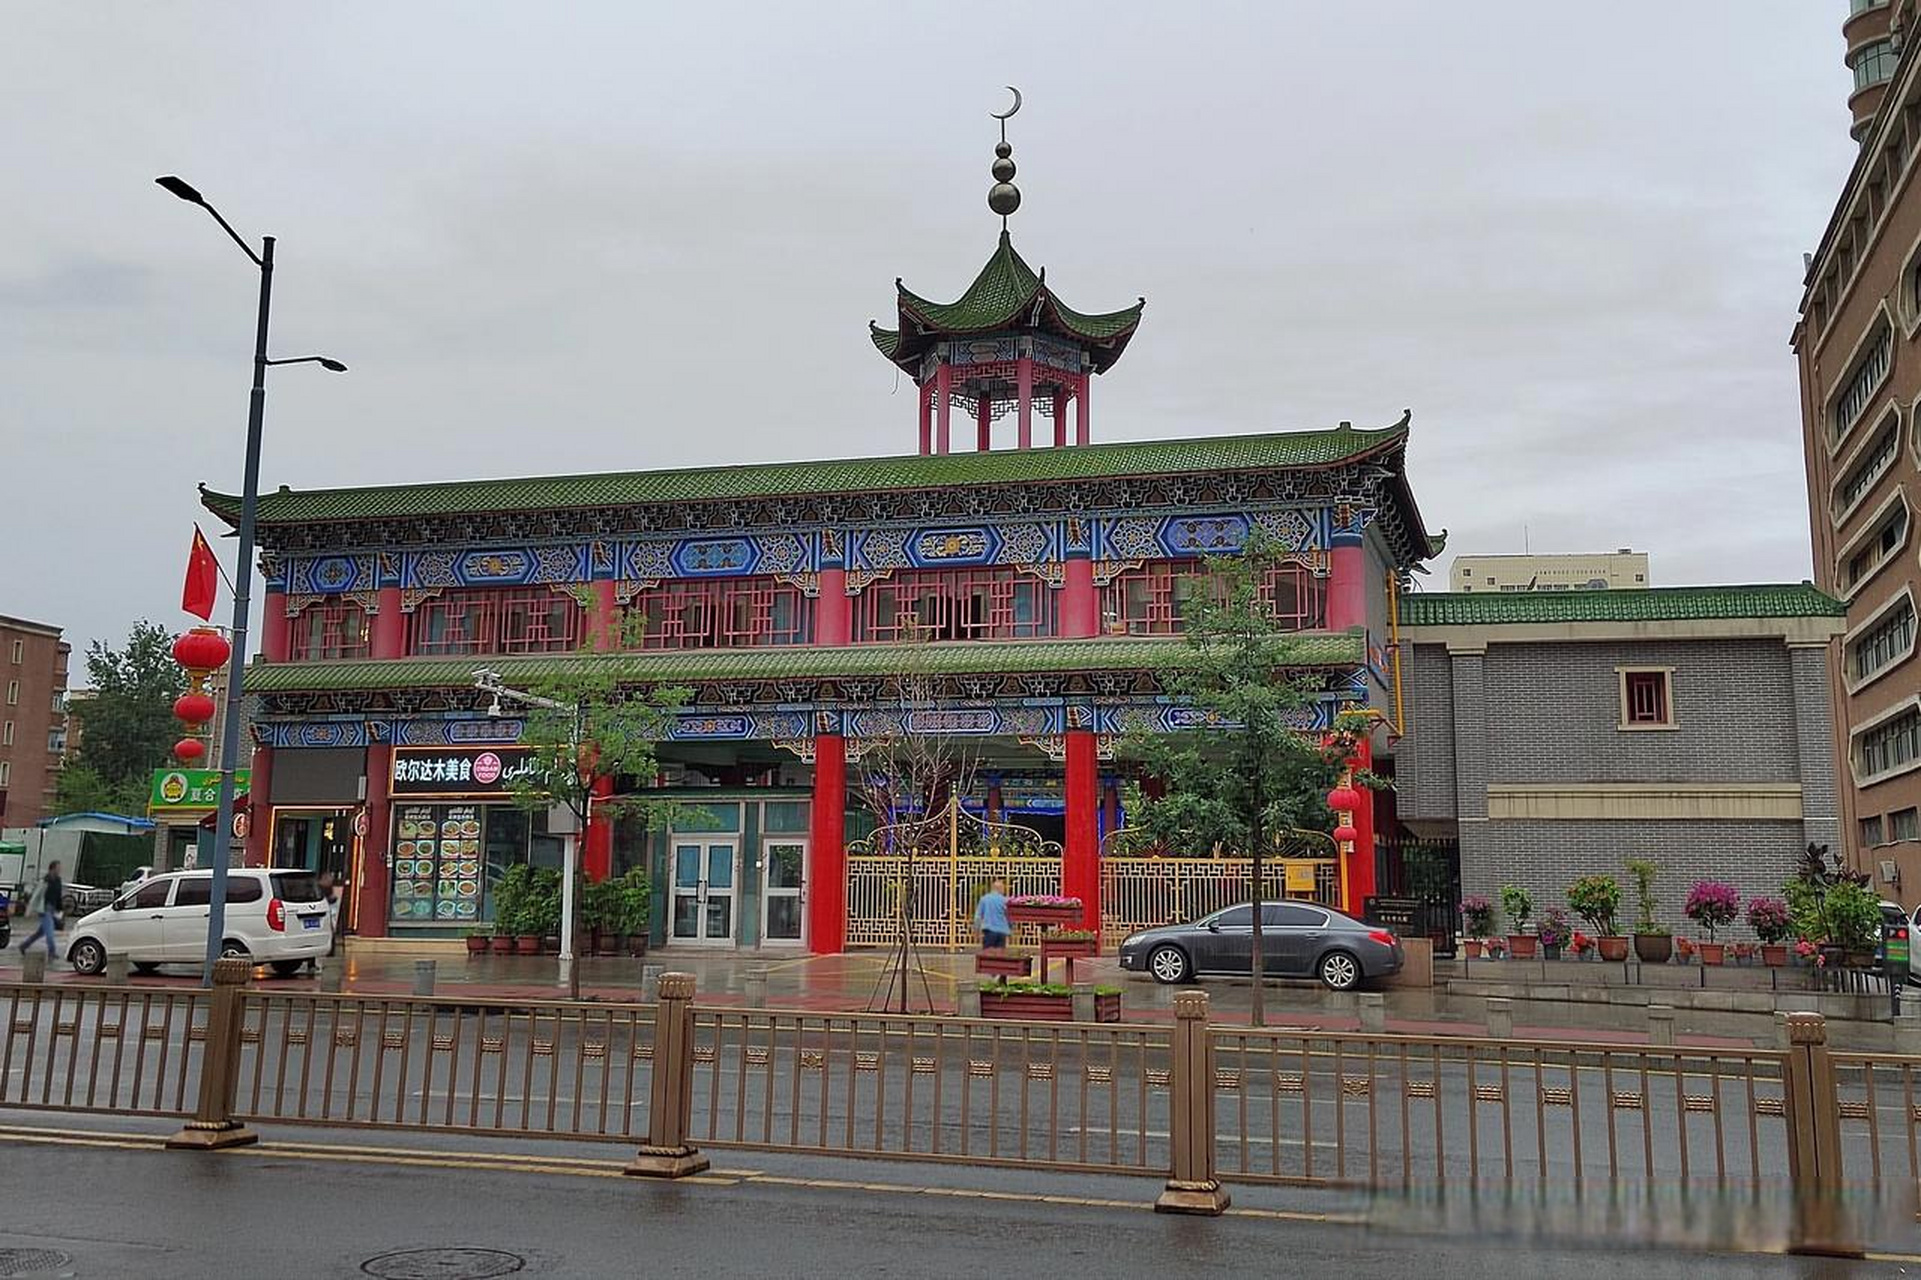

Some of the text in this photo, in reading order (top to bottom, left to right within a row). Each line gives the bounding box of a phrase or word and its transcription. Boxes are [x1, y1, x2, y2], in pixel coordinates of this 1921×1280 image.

[395, 758, 472, 782] 欧尔达木美食
